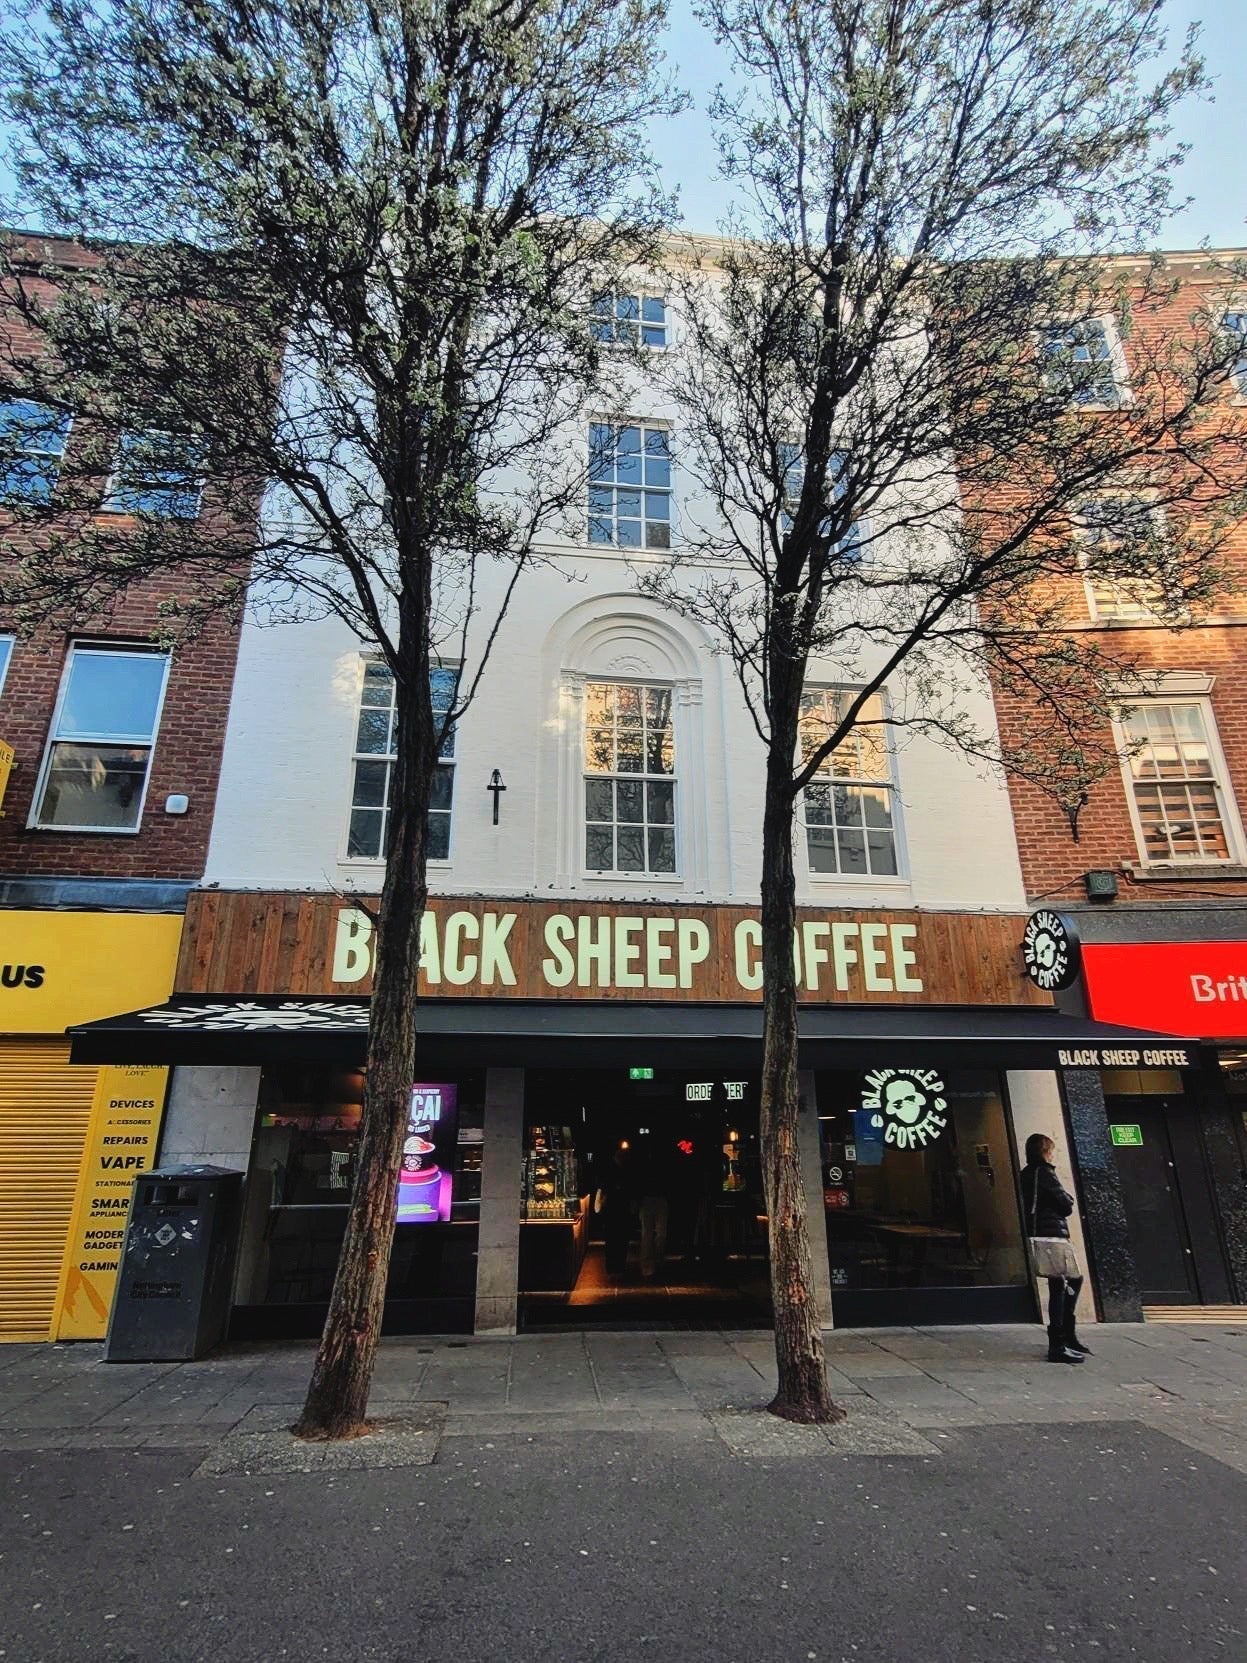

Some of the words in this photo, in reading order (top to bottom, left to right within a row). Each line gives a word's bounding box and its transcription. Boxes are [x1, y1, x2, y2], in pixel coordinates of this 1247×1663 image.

[1024, 919, 1039, 964] BLACK
[1037, 912, 1064, 937] SHEEP
[332, 909, 517, 985] BACK
[542, 914, 710, 989] SHEEP
[734, 919, 923, 992] CFFEE
[1, 965, 45, 988] US
[1038, 952, 1068, 988] COFFEE
[1058, 1050, 1100, 1065] BLACK
[1101, 1050, 1140, 1065] SHEEP
[1143, 1050, 1189, 1065] COFFEE
[898, 1069, 945, 1092] EEP
[687, 1085, 712, 1099] ORDE
[109, 1100, 155, 1108] DEVICES
[409, 1095, 440, 1125] ÇAI
[885, 1110, 947, 1149] COFFEE
[103, 1136, 149, 1145] REPAIRS
[100, 1156, 146, 1169] VAPE
[91, 1199, 129, 1208] SMAR
[85, 1231, 124, 1239] MODER
[83, 1242, 123, 1250] GADGET
[79, 1262, 119, 1271] GAMIN
